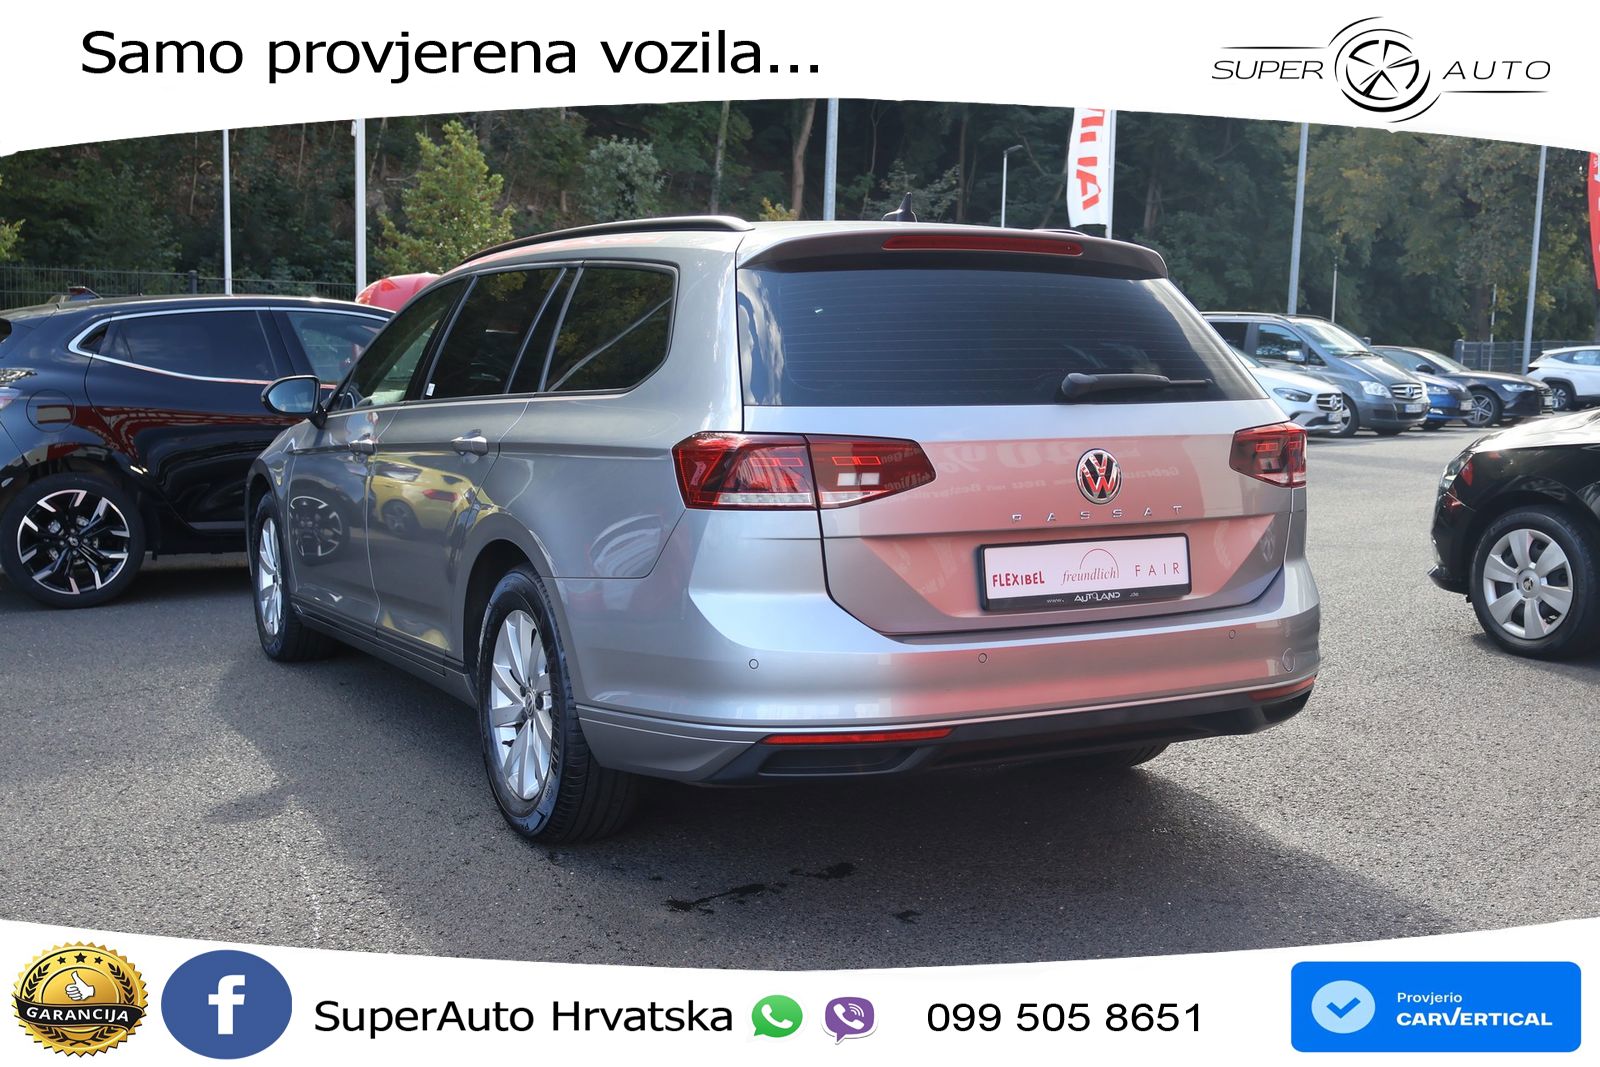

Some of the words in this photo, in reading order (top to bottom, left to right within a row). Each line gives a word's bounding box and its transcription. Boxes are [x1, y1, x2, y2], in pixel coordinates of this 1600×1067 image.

[1012, 505, 1183, 522] PASSAT
[1061, 566, 1117, 586] freundlich
[1134, 562, 1180, 577] FAIR
